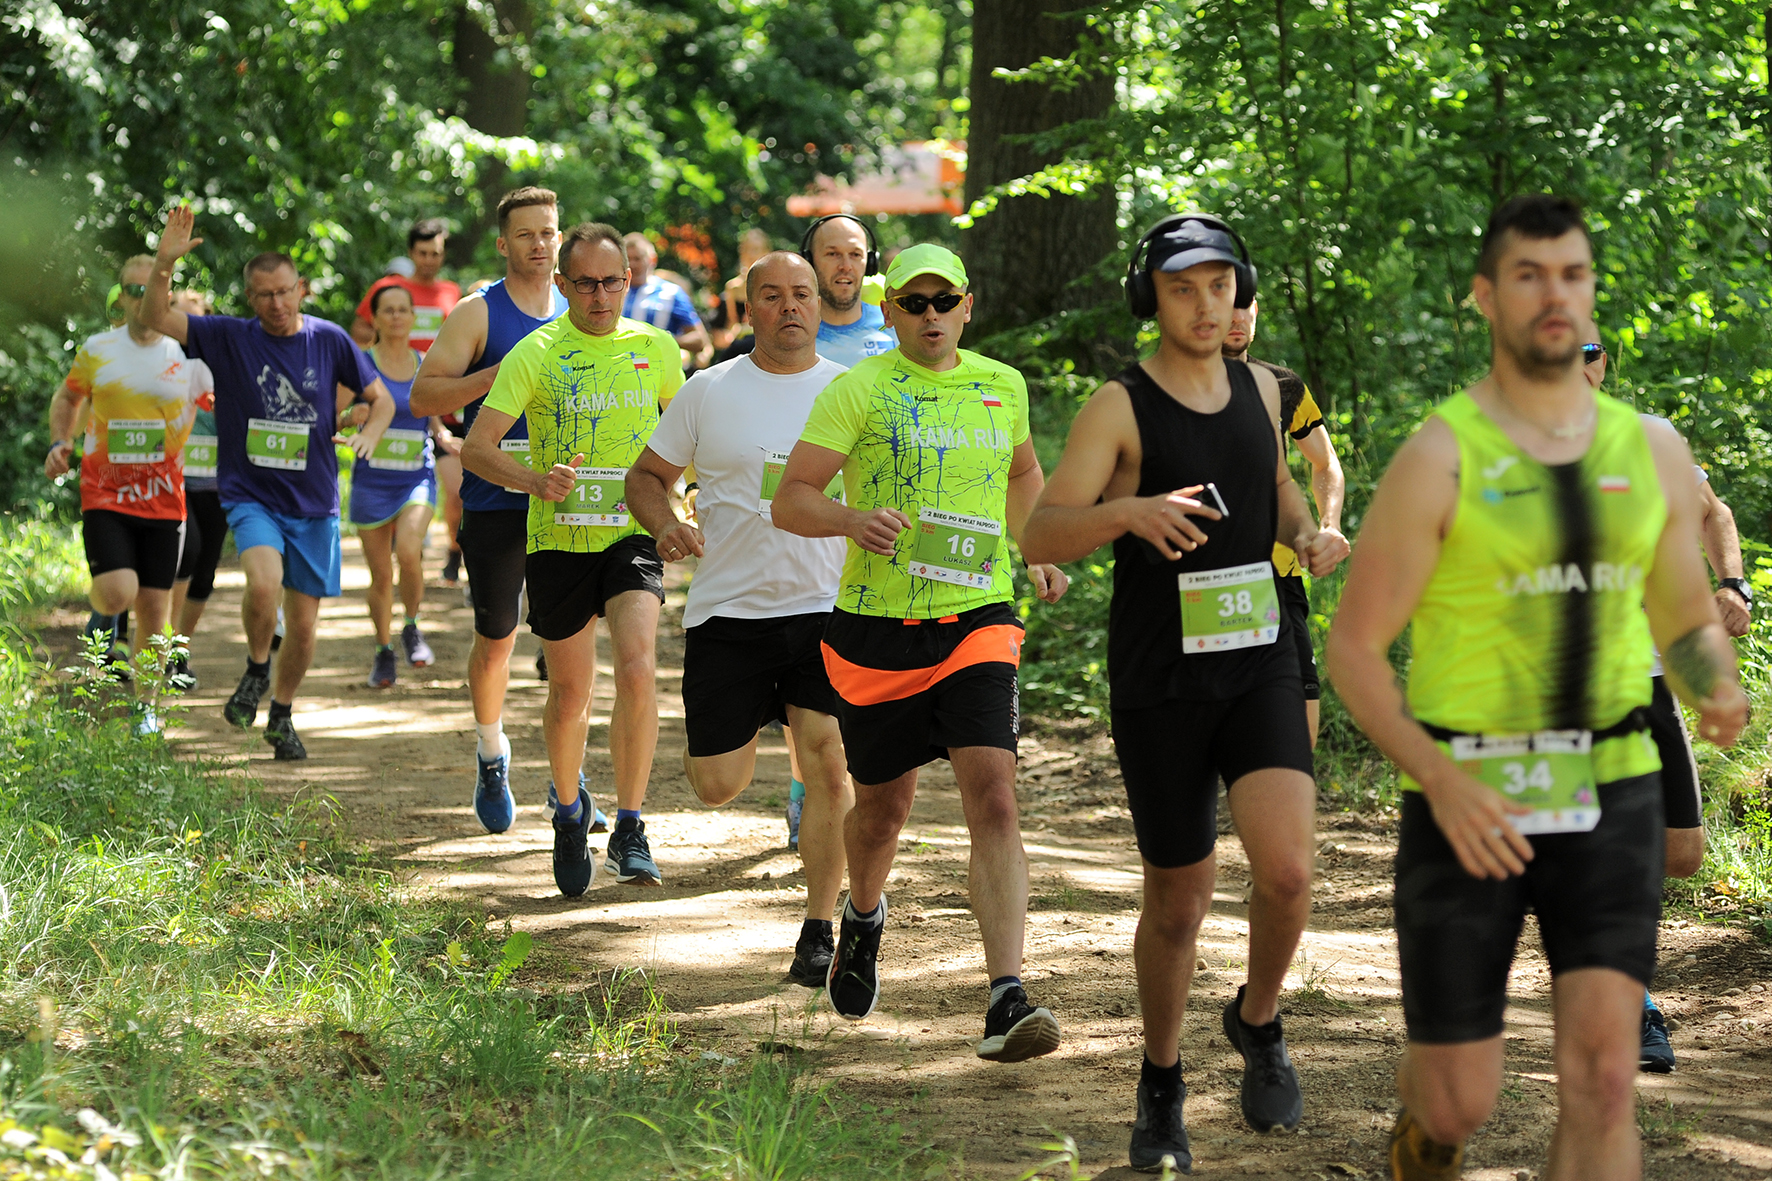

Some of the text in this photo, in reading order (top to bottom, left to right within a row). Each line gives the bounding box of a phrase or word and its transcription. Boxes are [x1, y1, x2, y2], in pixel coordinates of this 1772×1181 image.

[565, 389, 653, 414] KAMA RUN
[125, 431, 147, 447] 39
[266, 434, 287, 450] 61
[909, 426, 1010, 451] KAMA RUN
[116, 473, 173, 504] RUN
[575, 484, 603, 503] 13
[927, 510, 933, 518] 2
[933, 512, 948, 521] BIEG
[948, 515, 958, 523] PO
[958, 517, 976, 526] KWIAT
[976, 520, 996, 530] PAPROCI
[947, 534, 976, 558] 16
[943, 556, 972, 566] ŁUKASZ
[1217, 589, 1253, 618] 38
[1502, 760, 1555, 796] 34
